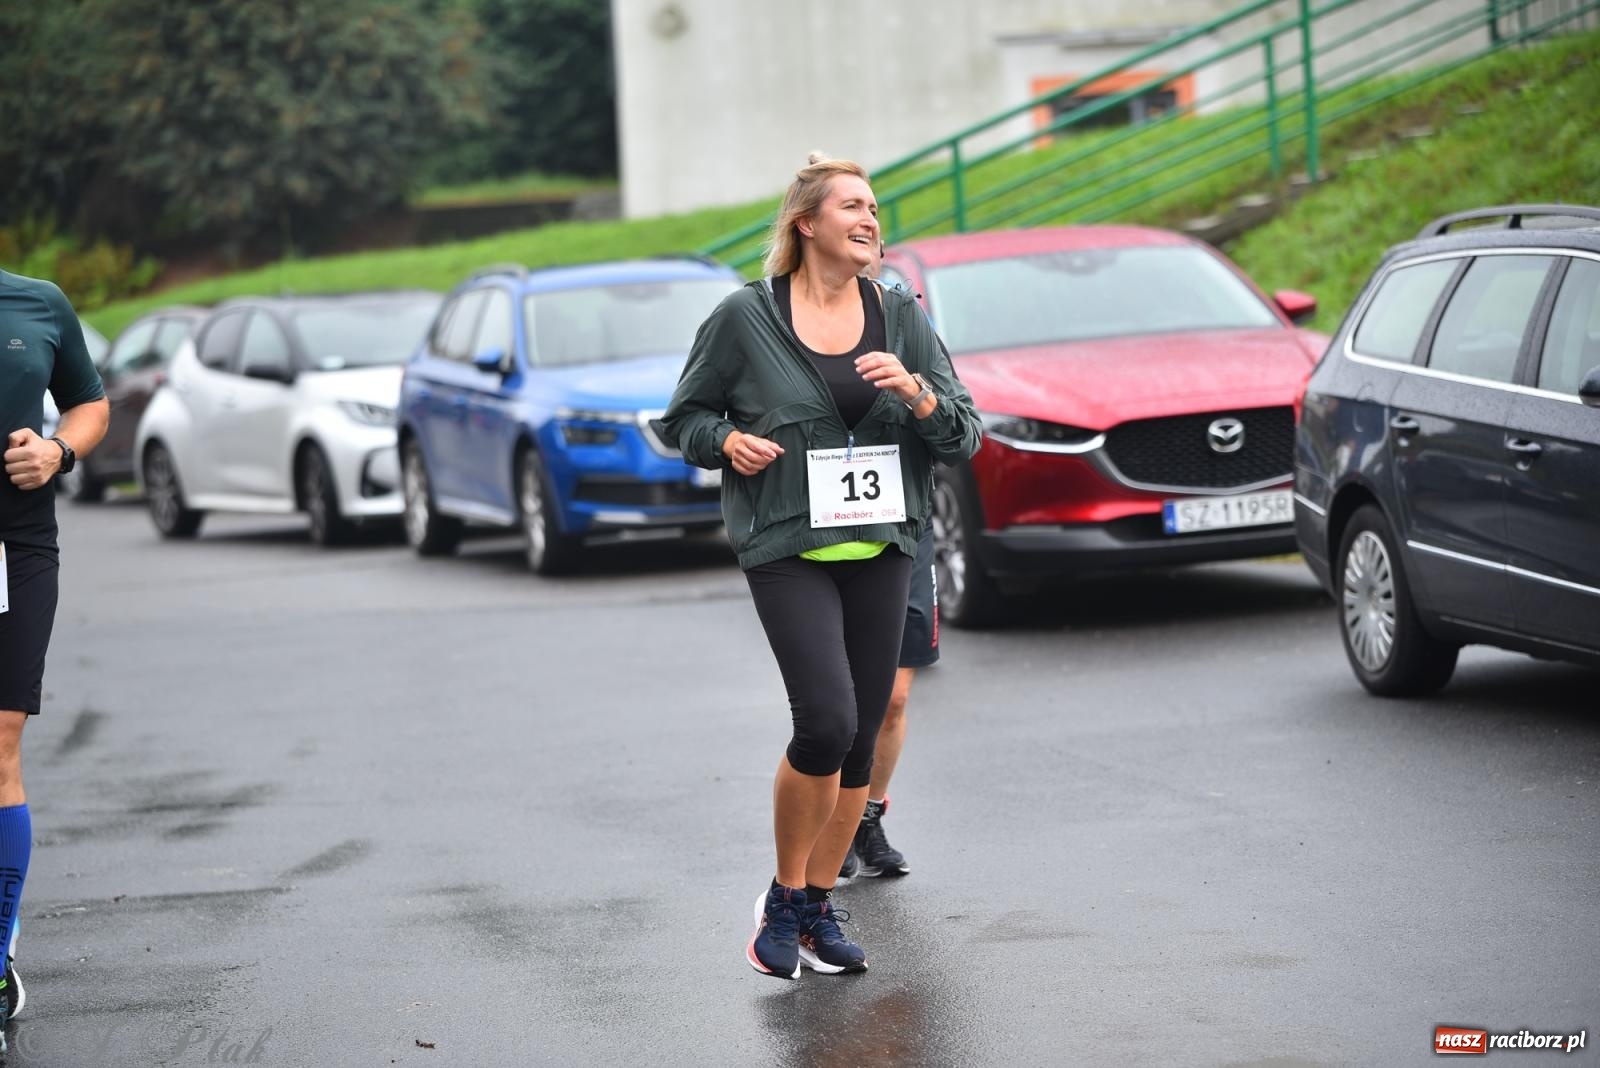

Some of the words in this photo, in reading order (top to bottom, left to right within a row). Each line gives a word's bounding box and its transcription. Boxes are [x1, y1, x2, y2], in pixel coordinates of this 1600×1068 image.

[841, 470, 881, 502] 13
[834, 511, 874, 520] Racibórz
[1181, 502, 1209, 529] SZ
